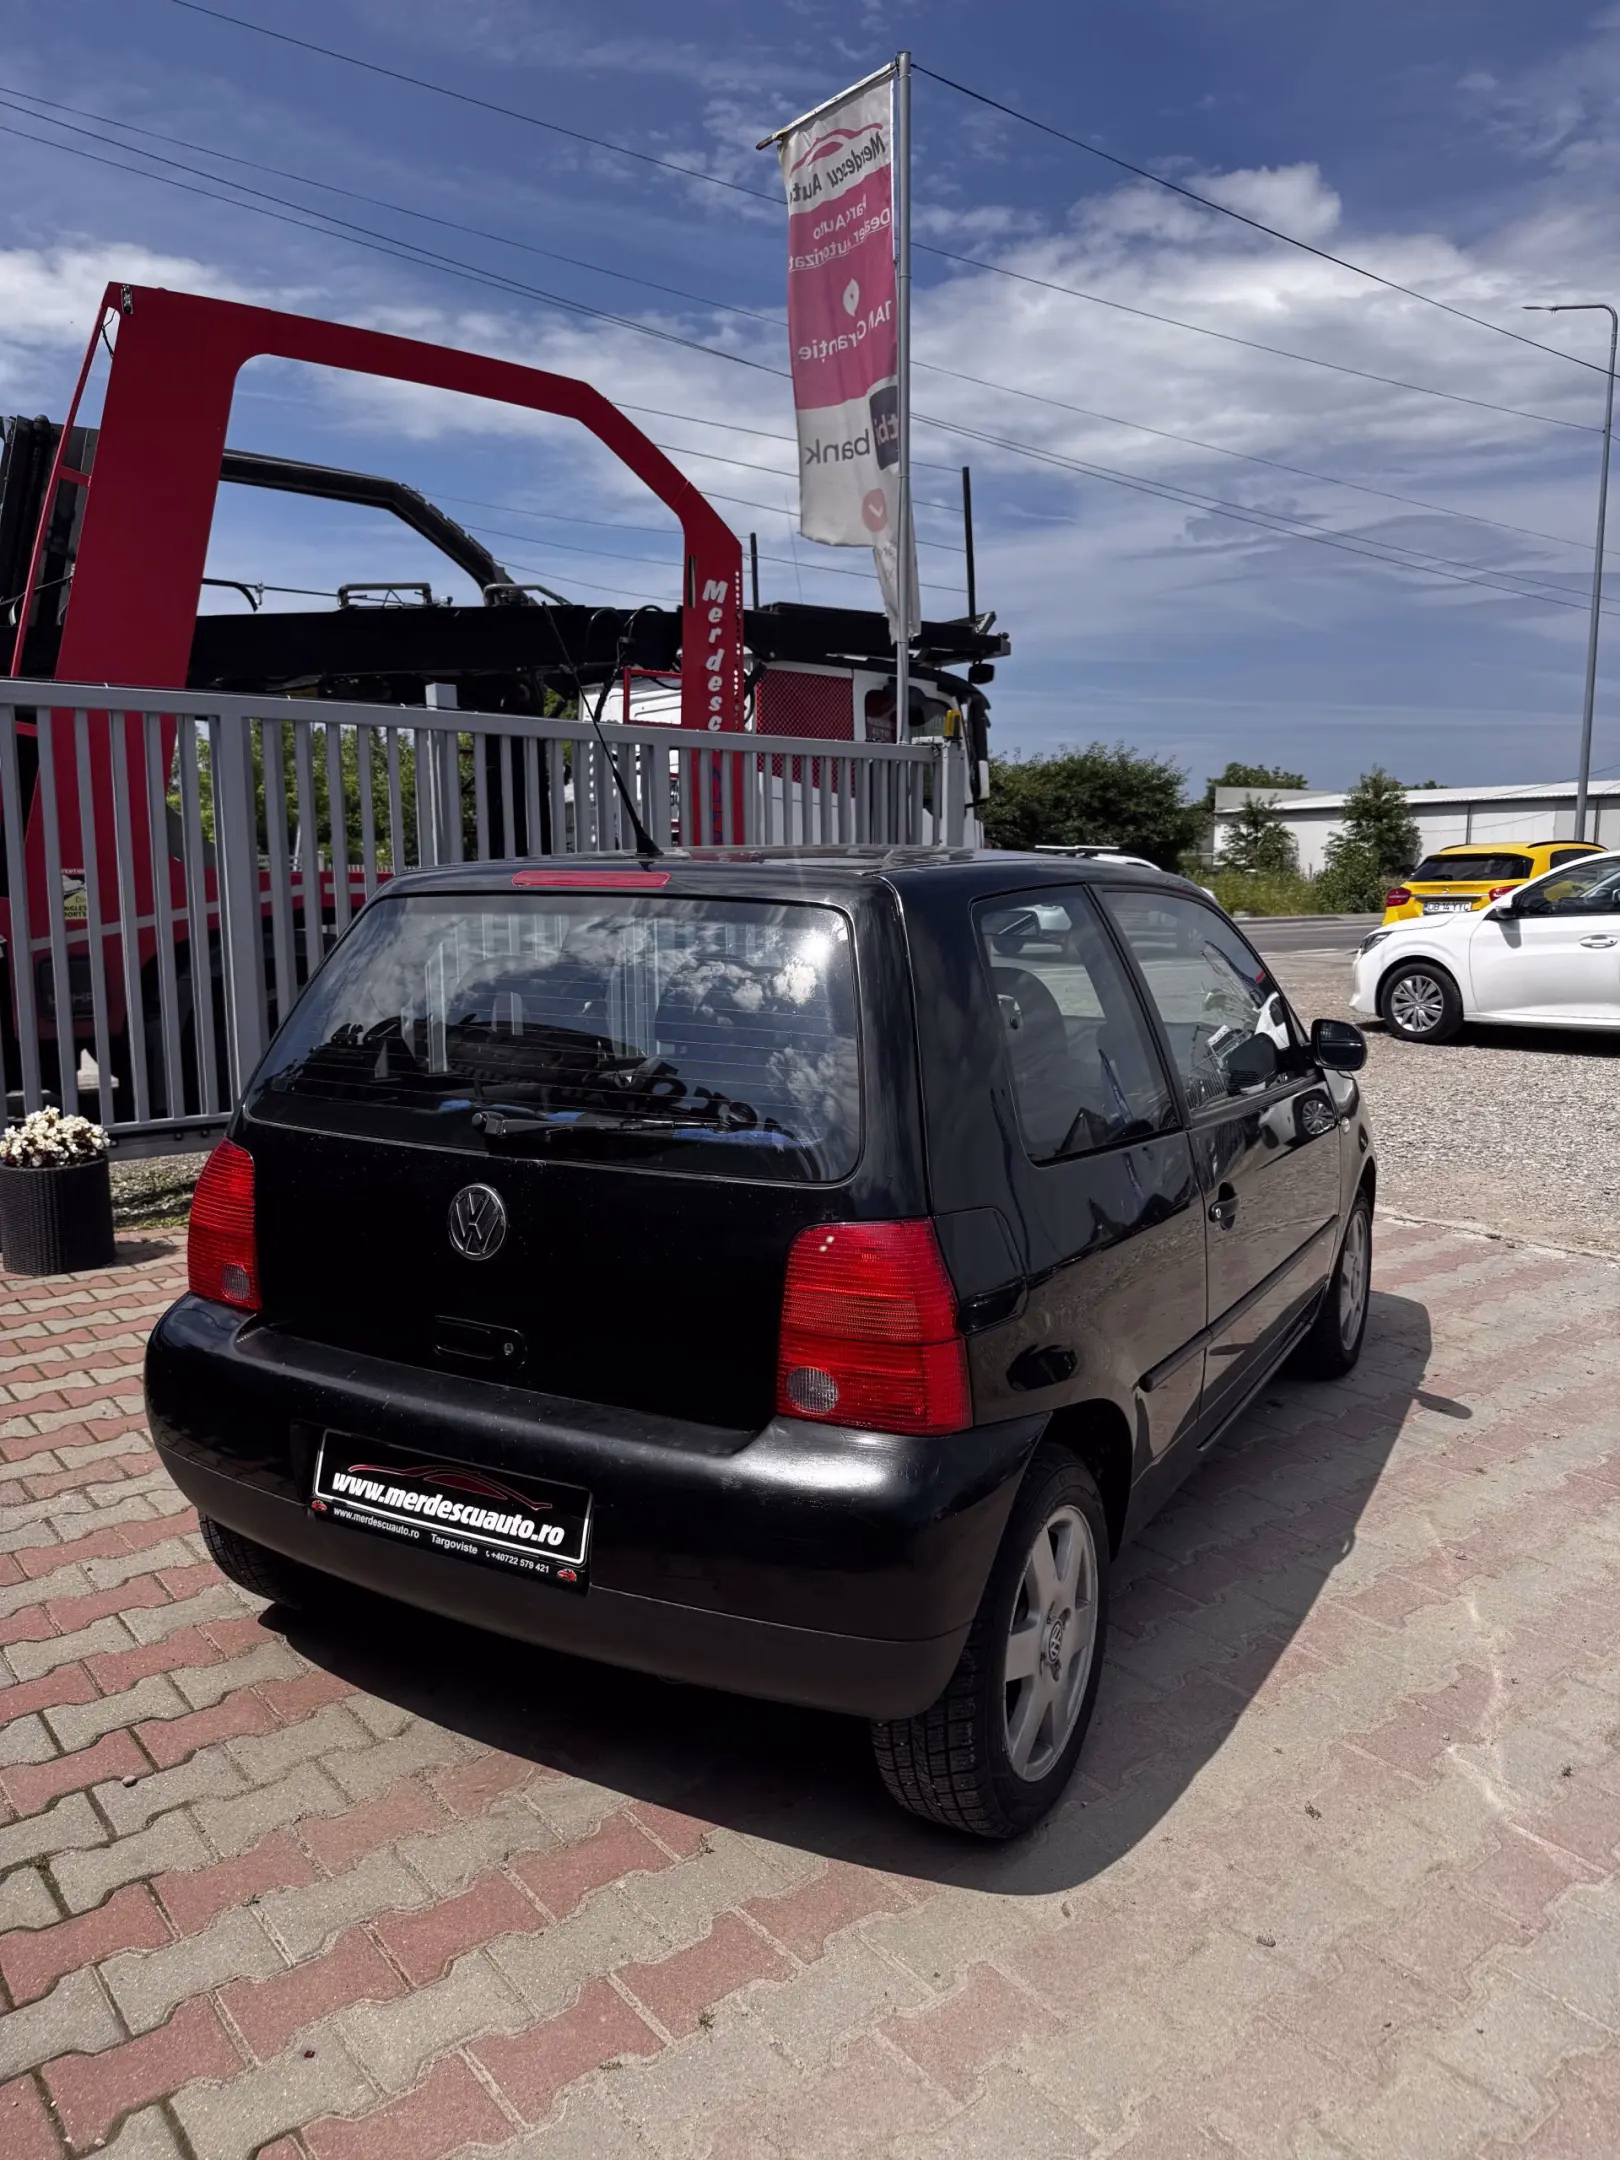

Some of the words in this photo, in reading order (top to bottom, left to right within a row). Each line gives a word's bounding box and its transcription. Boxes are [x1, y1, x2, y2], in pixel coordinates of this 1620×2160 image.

[702, 579, 729, 751] Merdesc
[331, 1472, 565, 1546] www.merdescuauto.ro
[333, 1507, 420, 1539] www.merdescuauto.ro
[430, 1533, 478, 1555] Targoviste
[490, 1552, 518, 1566] +40722
[519, 1558, 534, 1570] 579
[535, 1562, 550, 1574] 421
